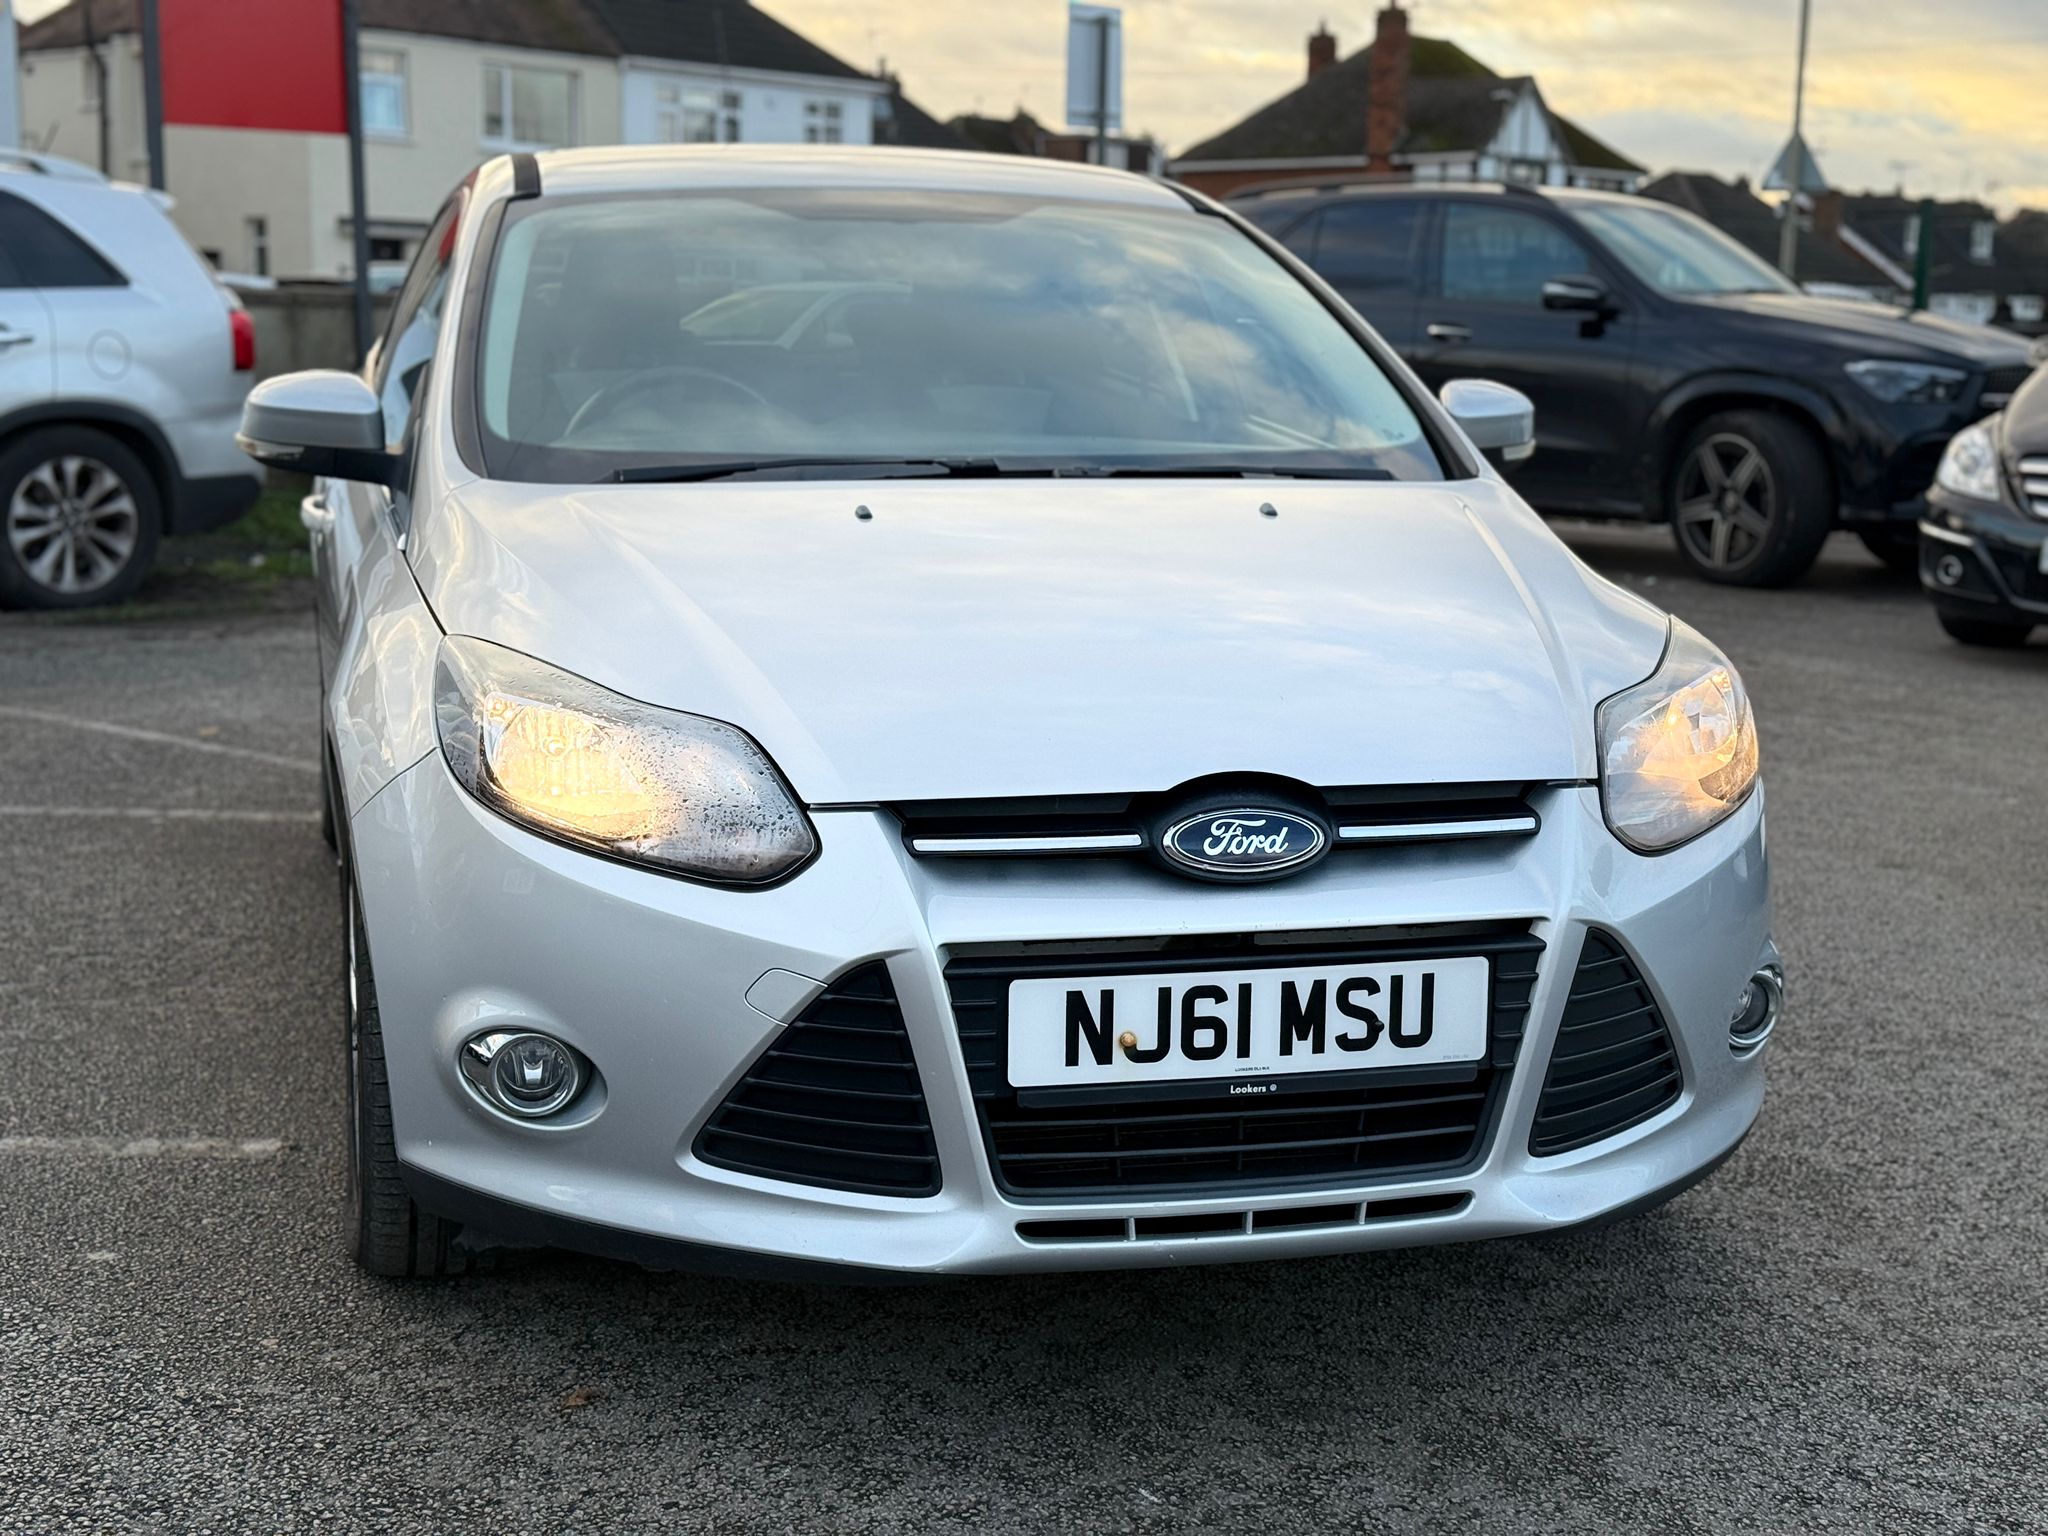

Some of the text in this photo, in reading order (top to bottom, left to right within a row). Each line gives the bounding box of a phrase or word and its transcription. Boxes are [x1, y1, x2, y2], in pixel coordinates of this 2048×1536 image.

[1203, 818, 1289, 856] Ford
[1065, 972, 1435, 1067] NJ61 MSU
[1230, 1083, 1267, 1094] Lookers
